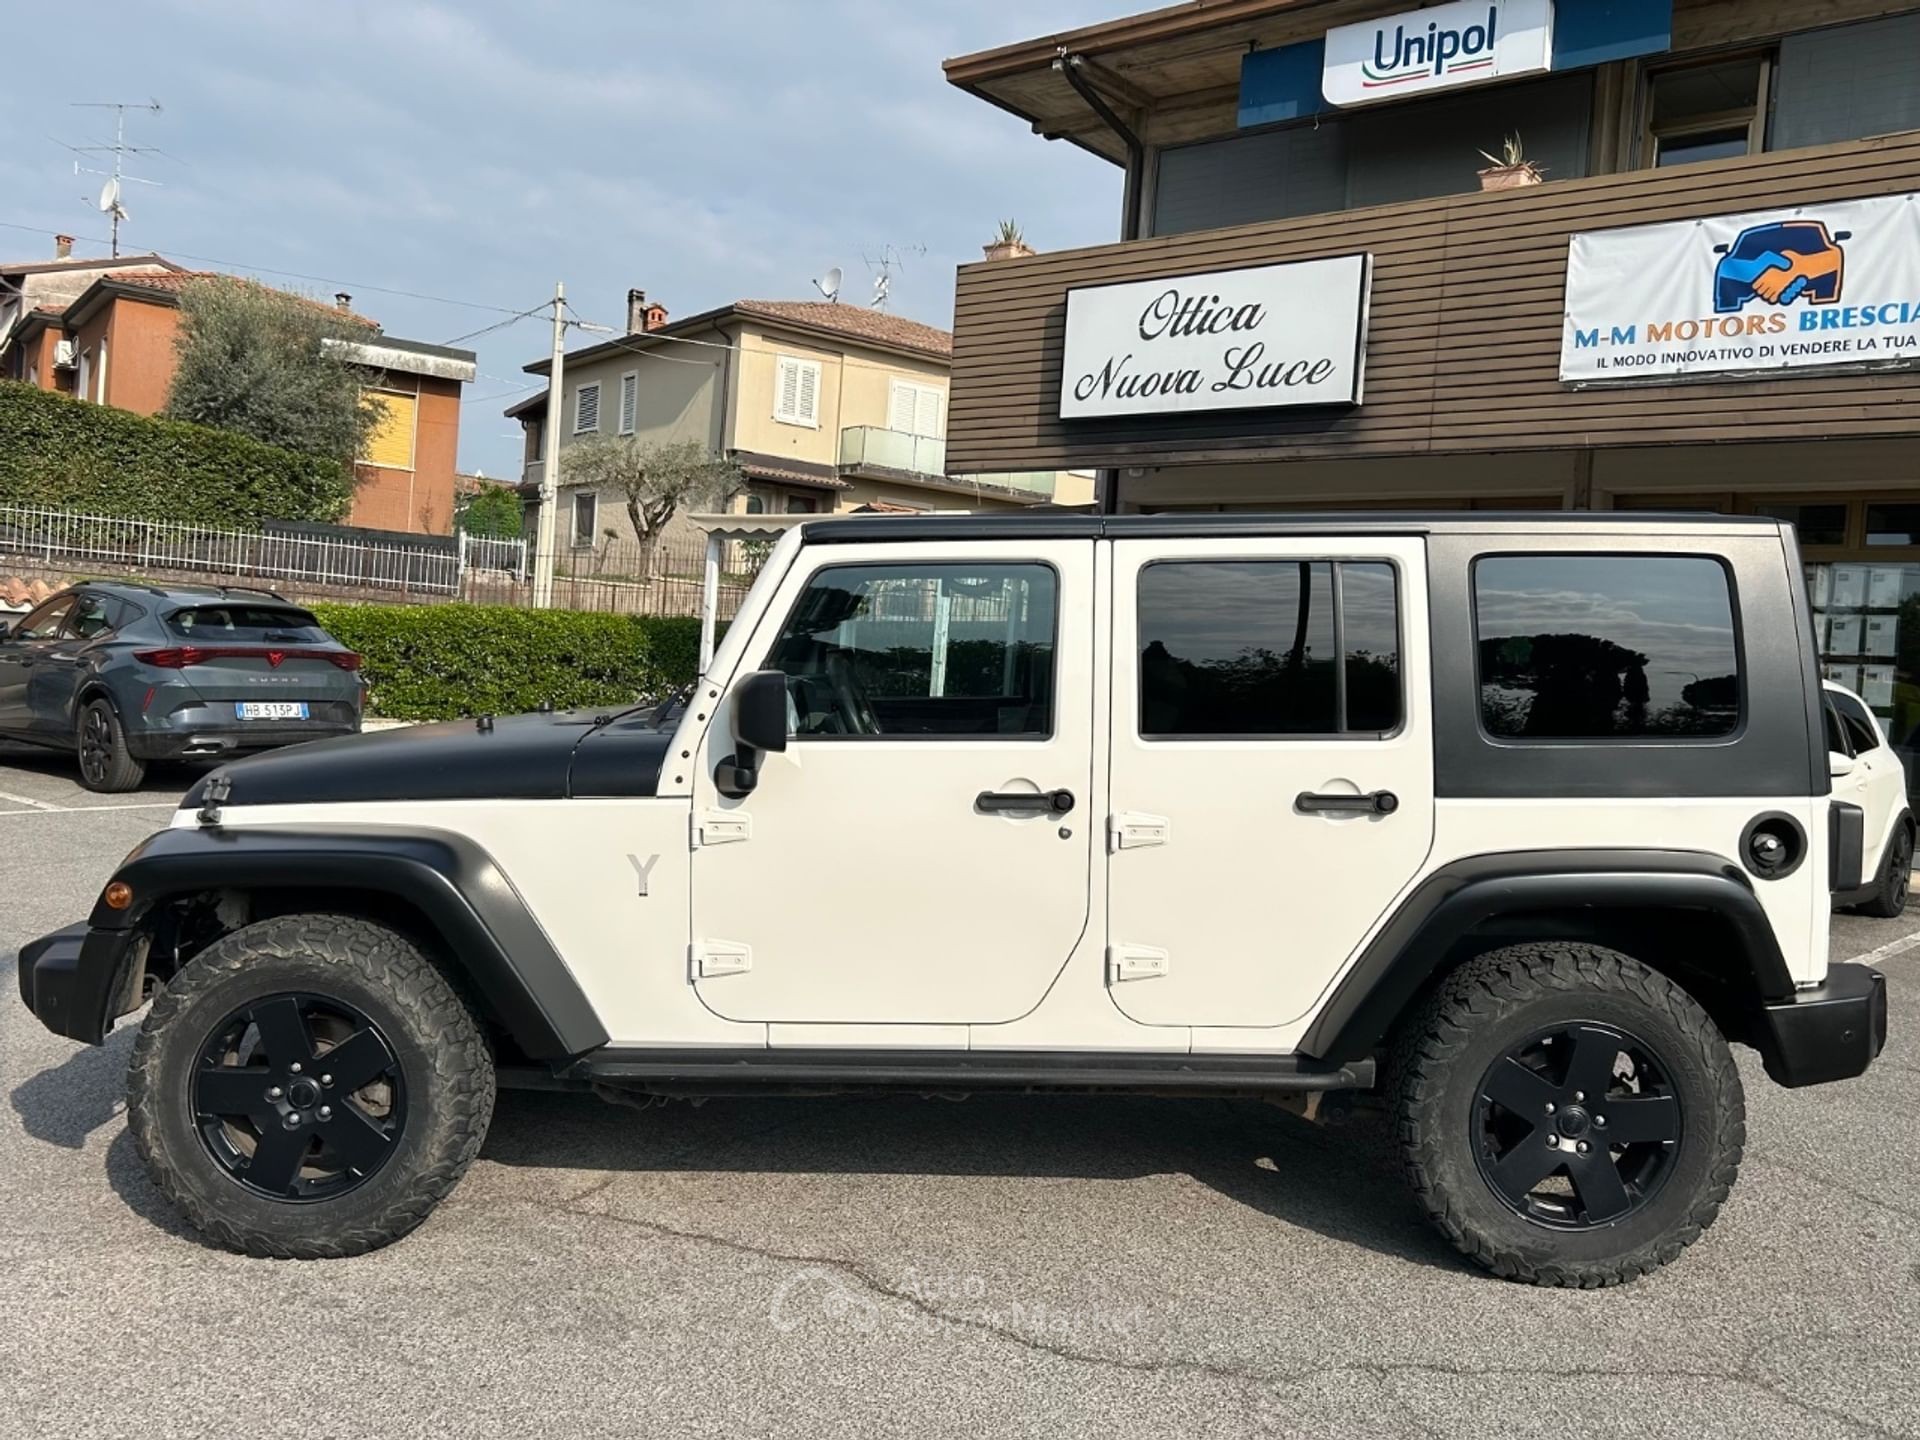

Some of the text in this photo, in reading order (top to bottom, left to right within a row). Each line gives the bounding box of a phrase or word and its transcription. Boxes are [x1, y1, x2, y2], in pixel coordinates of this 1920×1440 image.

[1374, 6, 1497, 75] Unipol
[1138, 289, 1266, 341] Ottica
[1575, 325, 1636, 348] M-M
[1647, 313, 1787, 343] MOTORS
[1074, 342, 1336, 401] Nuova Luce
[1597, 335, 1917, 368] IL MODO INNOVATIVO DI VENDERE LA TUA
